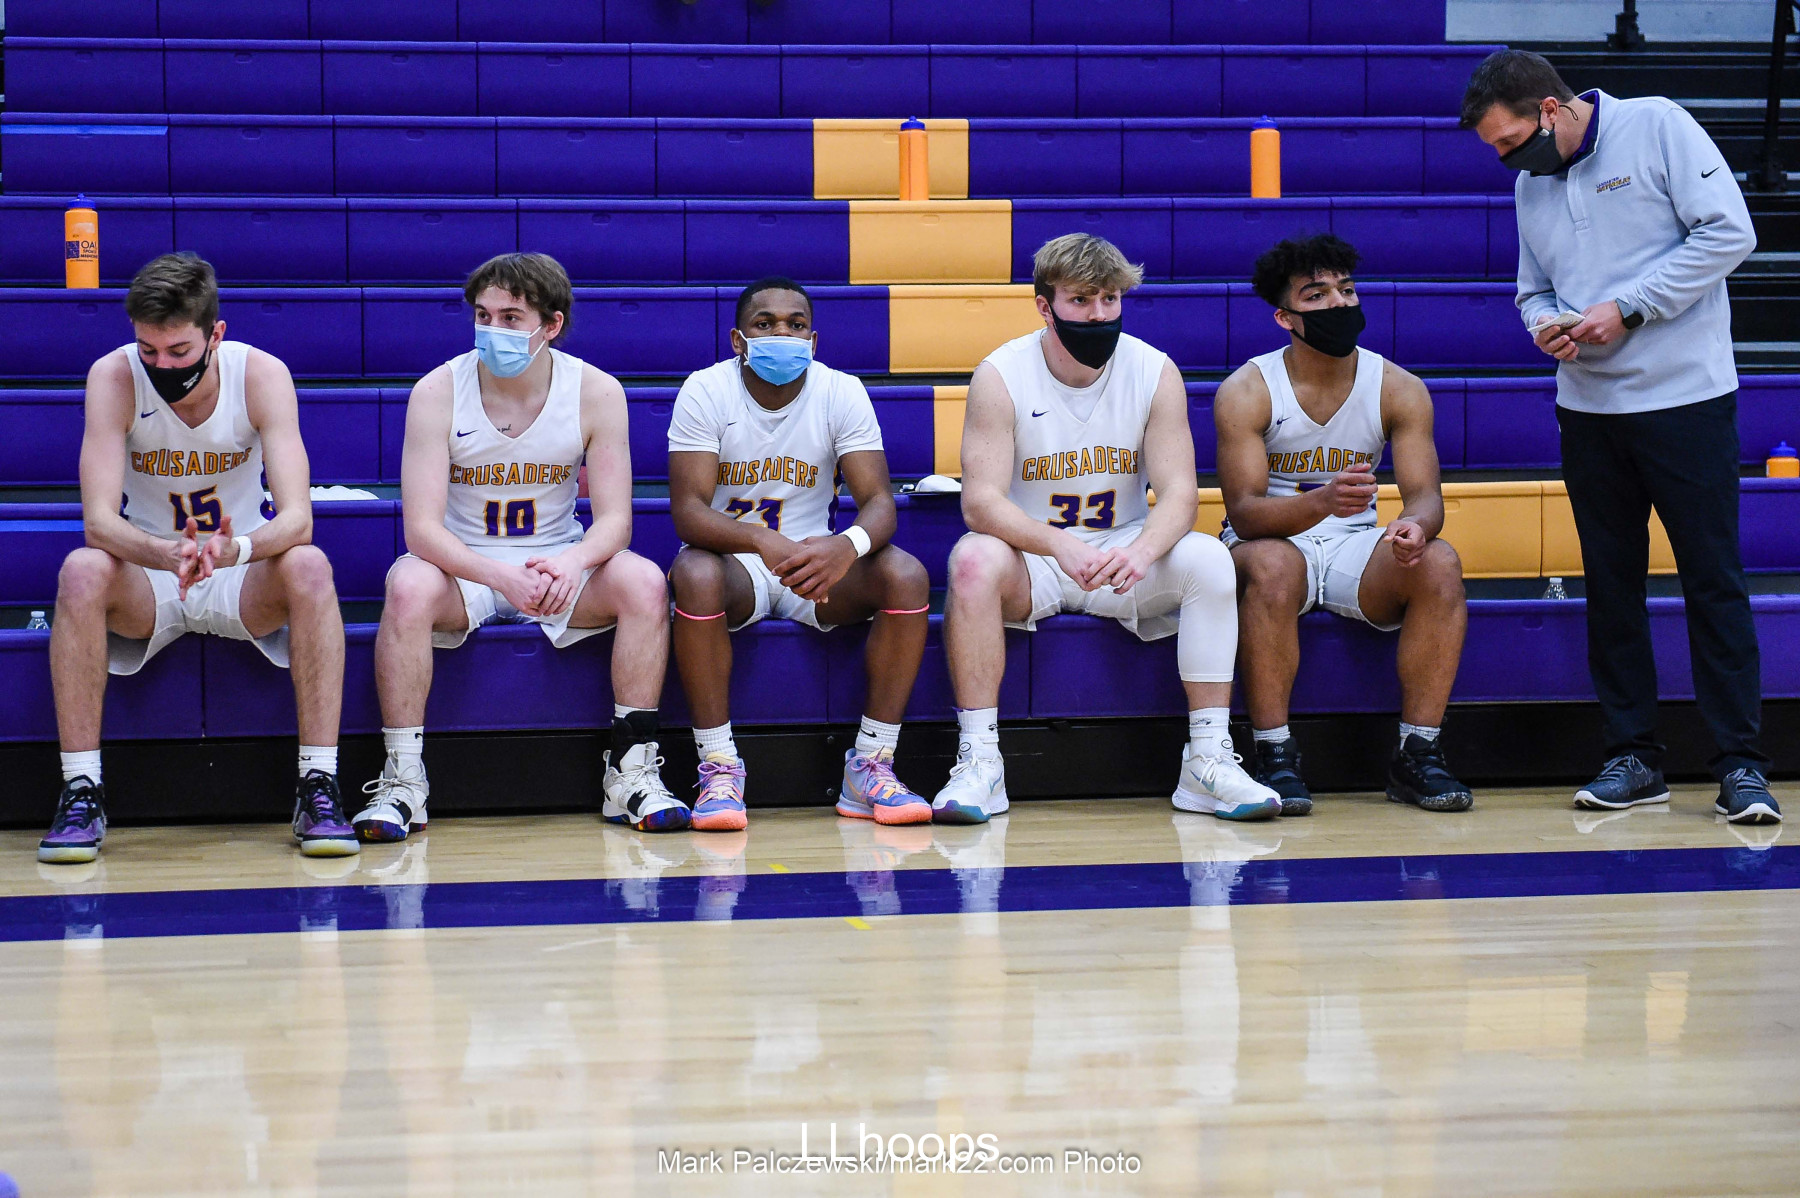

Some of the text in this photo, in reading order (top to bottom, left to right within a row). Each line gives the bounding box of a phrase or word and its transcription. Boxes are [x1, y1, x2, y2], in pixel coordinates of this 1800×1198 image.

[131, 447, 252, 477] CRUSADERS
[449, 463, 573, 486] CRUSADERS
[717, 456, 818, 488] RUSADERS
[1022, 445, 1138, 481] CRUSADERS
[168, 484, 224, 533] 15
[483, 498, 538, 537] 10
[1046, 488, 1117, 531] 33
